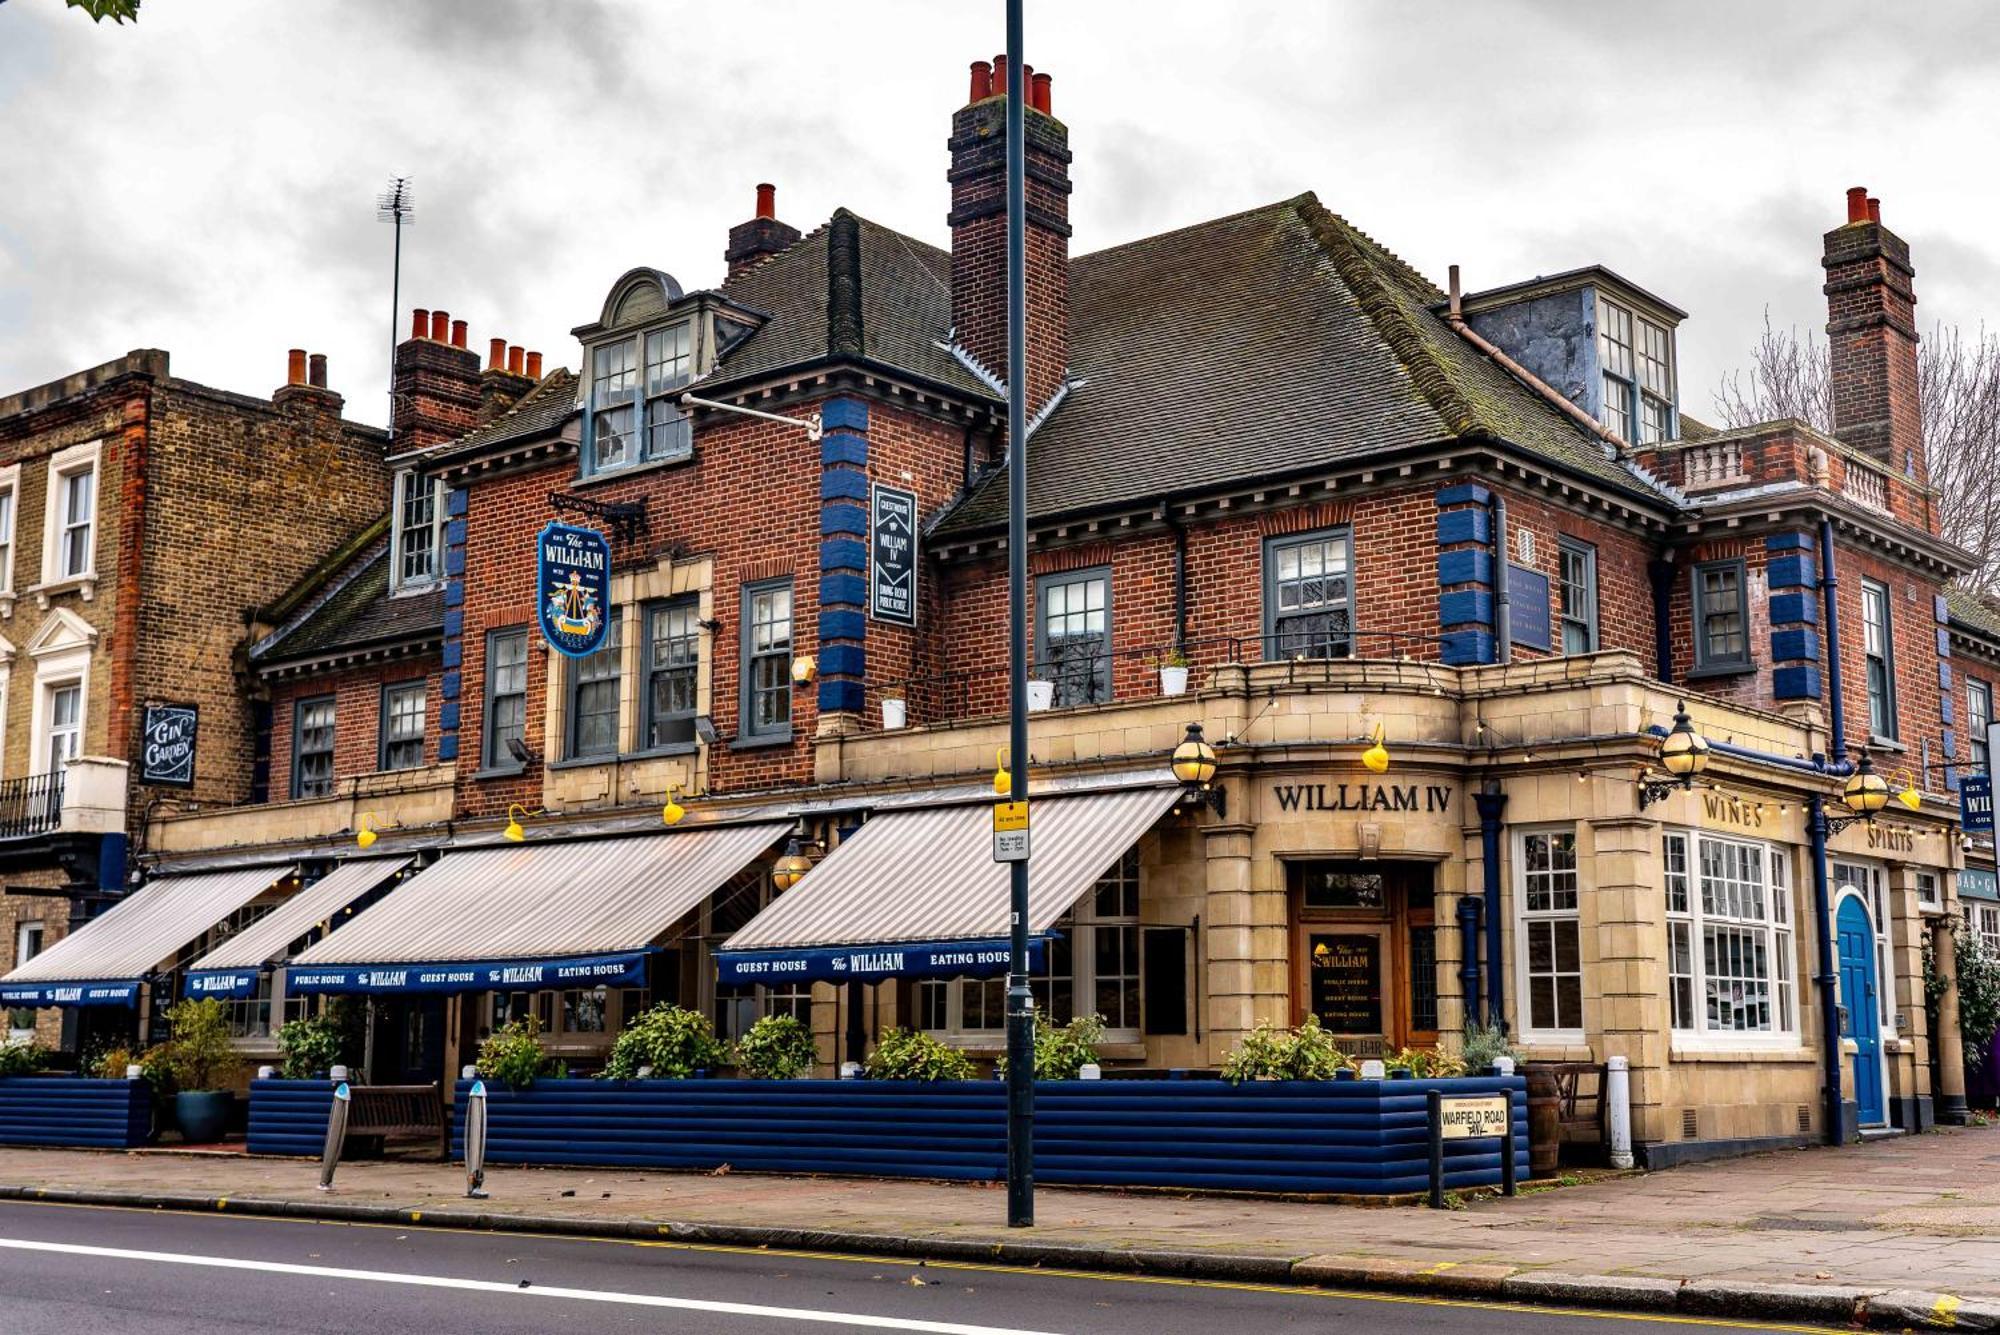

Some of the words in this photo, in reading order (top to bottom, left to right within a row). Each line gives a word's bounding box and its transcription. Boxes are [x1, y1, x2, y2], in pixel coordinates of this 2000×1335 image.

[566, 533, 584, 548] The
[880, 533, 908, 552] WILLIAM
[545, 544, 604, 571] WILLIAM
[890, 547, 898, 561] IV
[154, 717, 189, 744] GIN
[146, 735, 193, 767] GARDEN
[1274, 784, 1419, 812] WILLIAM
[1427, 785, 1452, 813] IV
[1703, 794, 1763, 828] WINES
[1867, 826, 1914, 852] SPIRITS
[736, 962, 770, 973] GUEST
[772, 960, 808, 972] HOUSE
[832, 957, 847, 971] The
[850, 953, 904, 972] WILLIAM
[930, 953, 974, 965] EATING
[977, 951, 1011, 963] HOUS
[1322, 955, 1369, 968] WILLIAM
[203, 976, 237, 991] WILLIAM
[295, 975, 320, 985] PUBLIC
[321, 975, 346, 985] HOUSE
[370, 971, 407, 986] WILLIAM
[420, 973, 447, 983] GUEST
[448, 972, 475, 982] HOUSE
[489, 971, 501, 982] The
[503, 967, 543, 983] WILLIAM
[558, 967, 592, 977] EATING
[593, 964, 625, 975] HOUSE
[1442, 1110, 1482, 1125] WARFIELD
[1484, 1109, 1505, 1124] ROAD
